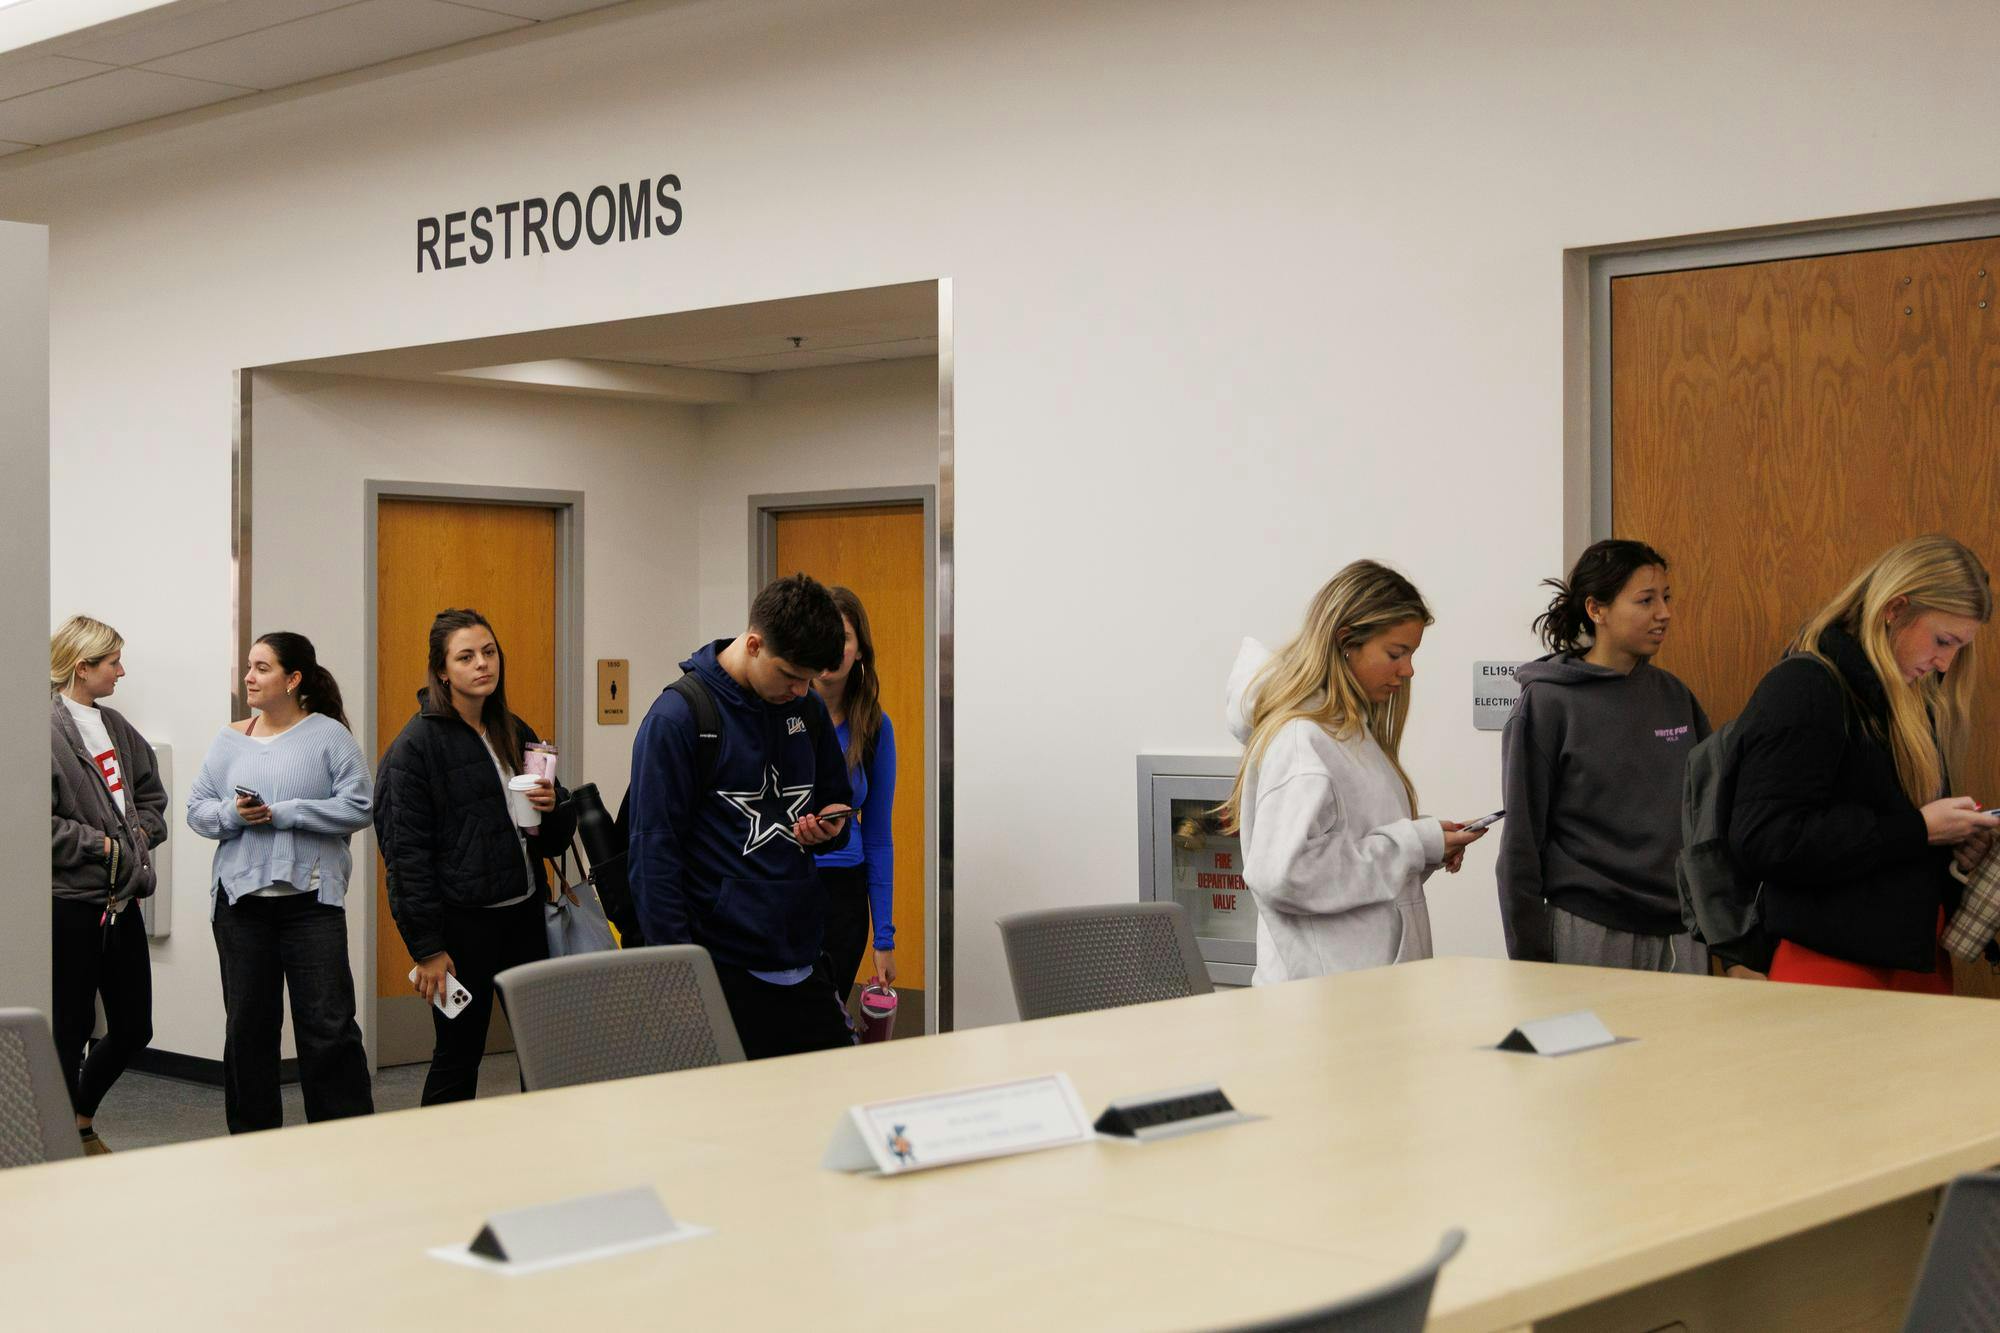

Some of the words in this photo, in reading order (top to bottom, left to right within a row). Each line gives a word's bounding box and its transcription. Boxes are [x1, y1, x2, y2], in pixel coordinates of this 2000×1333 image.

[417, 173, 683, 274] RESTROOMS
[1482, 665, 1520, 676] EL195
[1215, 852, 1232, 869] FIRE
[1197, 872, 1249, 890] DEPARTMEN
[1212, 893, 1236, 911] VALVE
